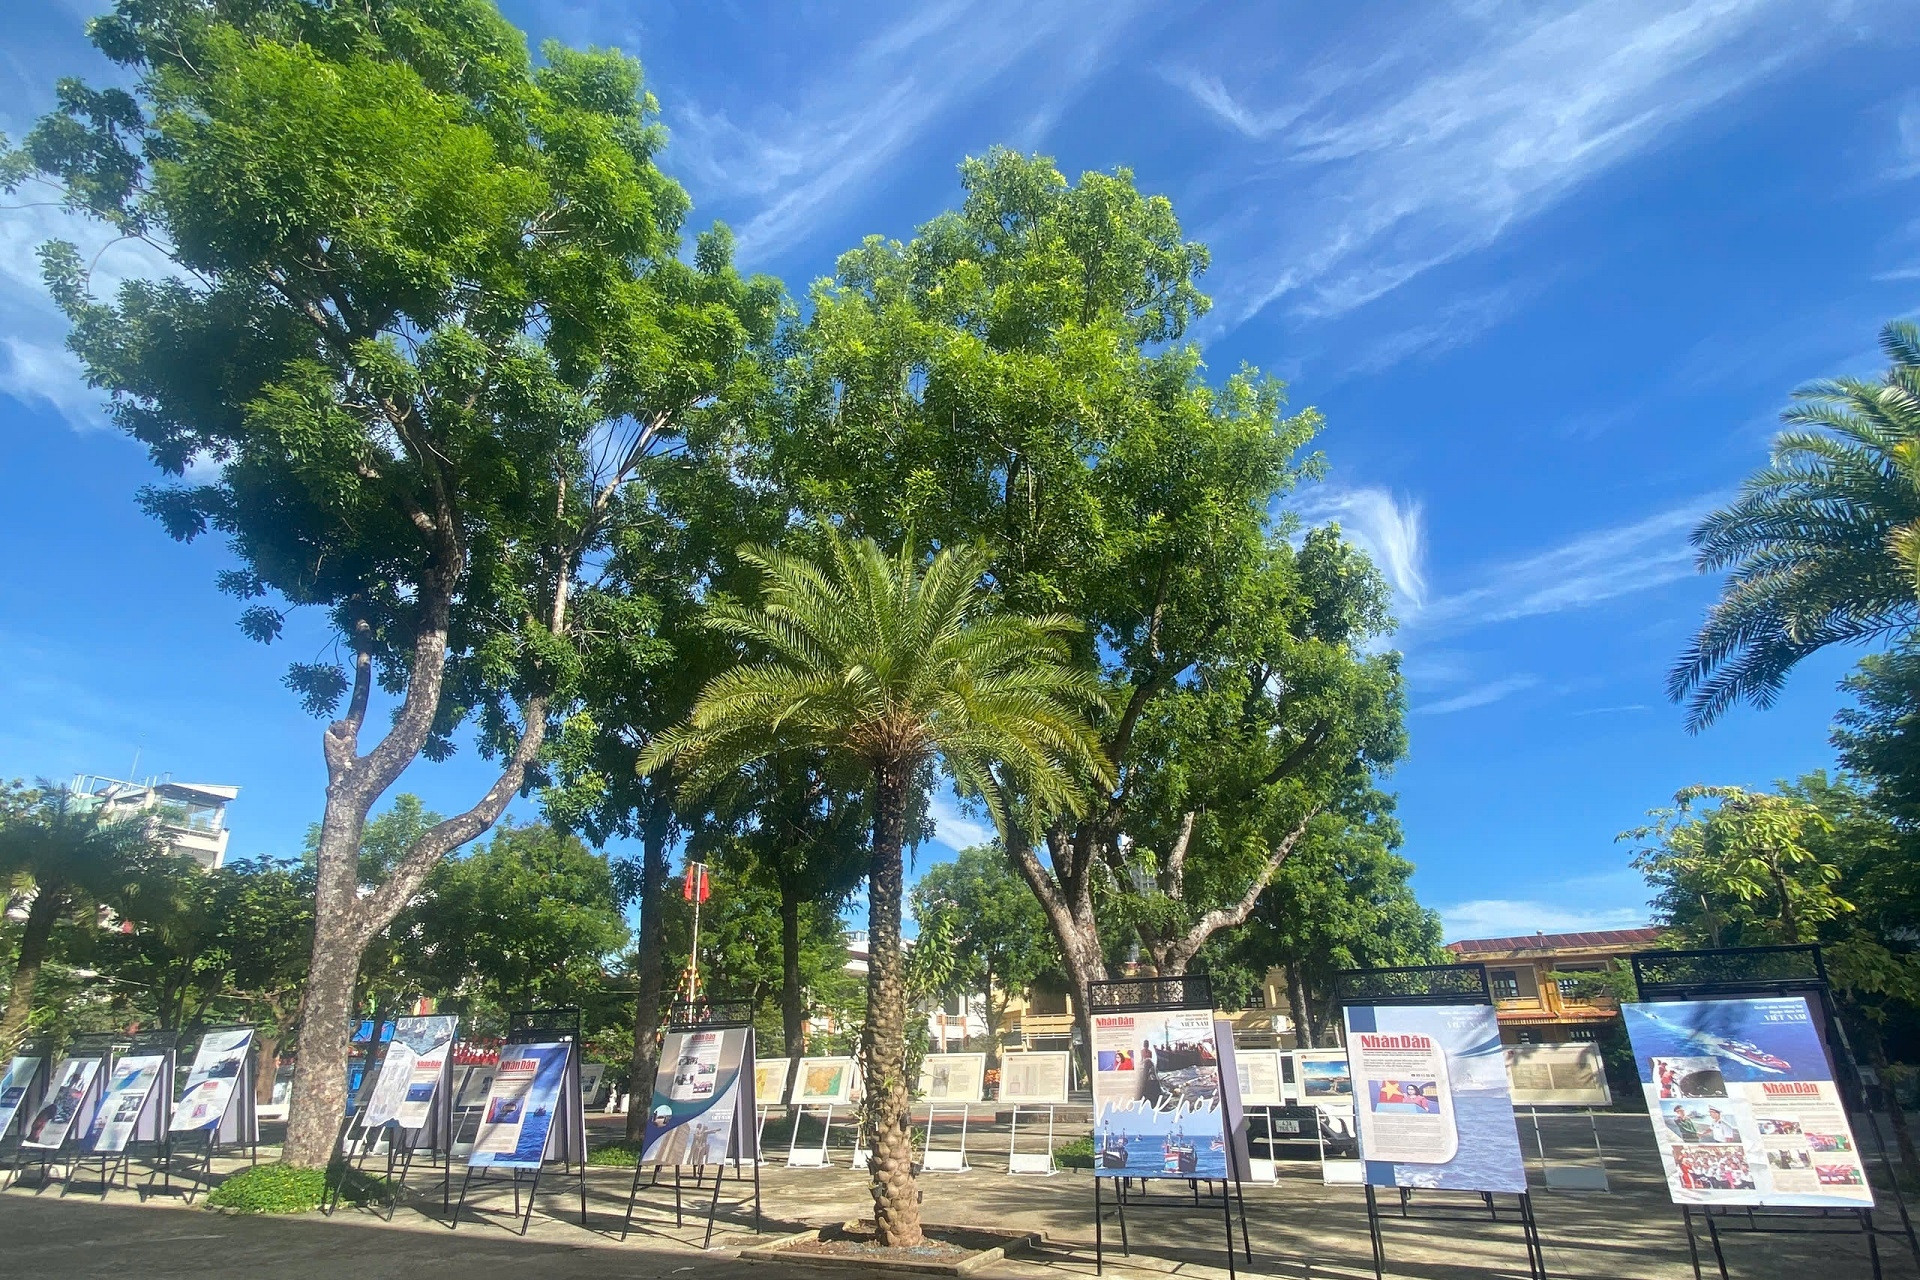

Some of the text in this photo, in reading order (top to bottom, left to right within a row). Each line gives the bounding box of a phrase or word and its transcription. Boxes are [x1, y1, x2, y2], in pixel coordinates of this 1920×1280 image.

[1096, 1016, 1134, 1027] Nhân Dân
[1361, 1034, 1431, 1049] Nhân Dân
[500, 1059, 537, 1070] Nhân Dân
[1762, 1082, 1818, 1094] Nhân Dân
